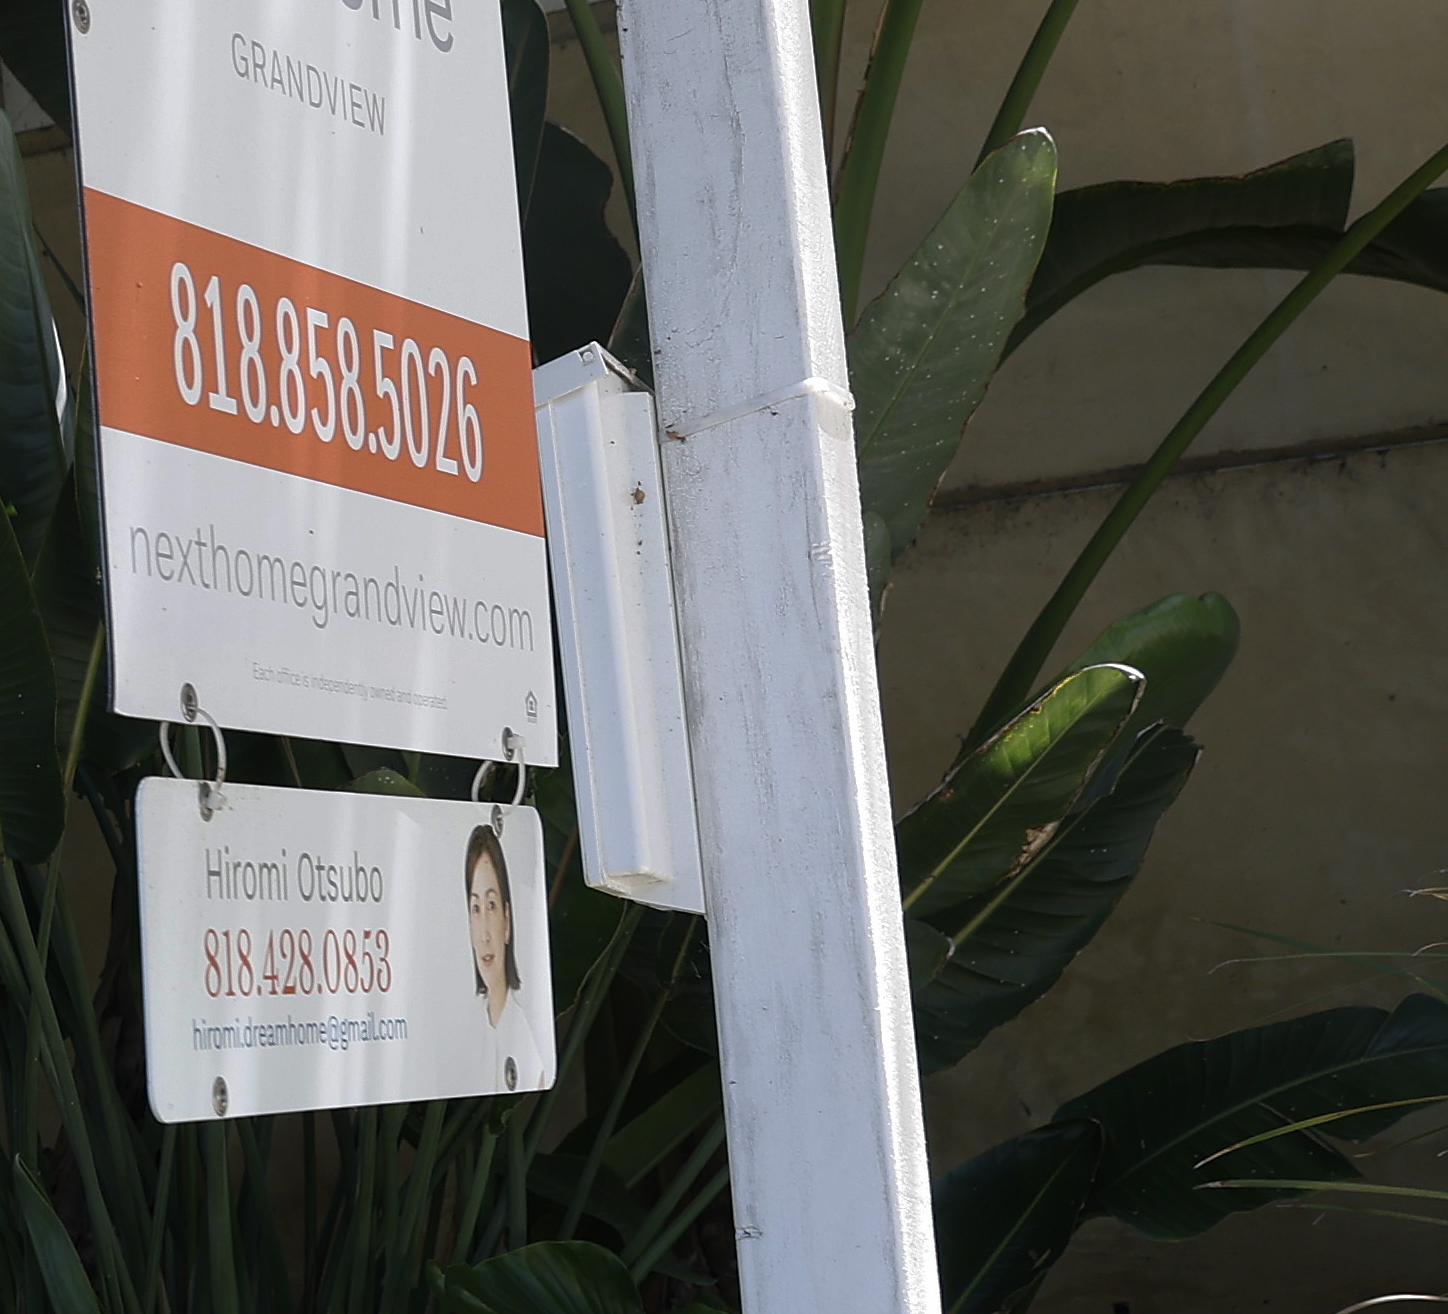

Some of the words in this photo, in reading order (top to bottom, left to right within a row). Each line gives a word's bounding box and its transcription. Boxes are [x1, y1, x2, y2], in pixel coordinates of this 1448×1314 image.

[230, 32, 386, 136] GRANDVIEW
[170, 261, 484, 483] 818.858.5026
[129, 523, 535, 652] nexthomegrandview.com
[205, 845, 289, 901] Hiromi
[297, 850, 384, 904] Otsubo
[203, 928, 393, 998] 818.428.0853
[191, 1011, 409, 1052] hiromi.dreamhome@gmail.com
